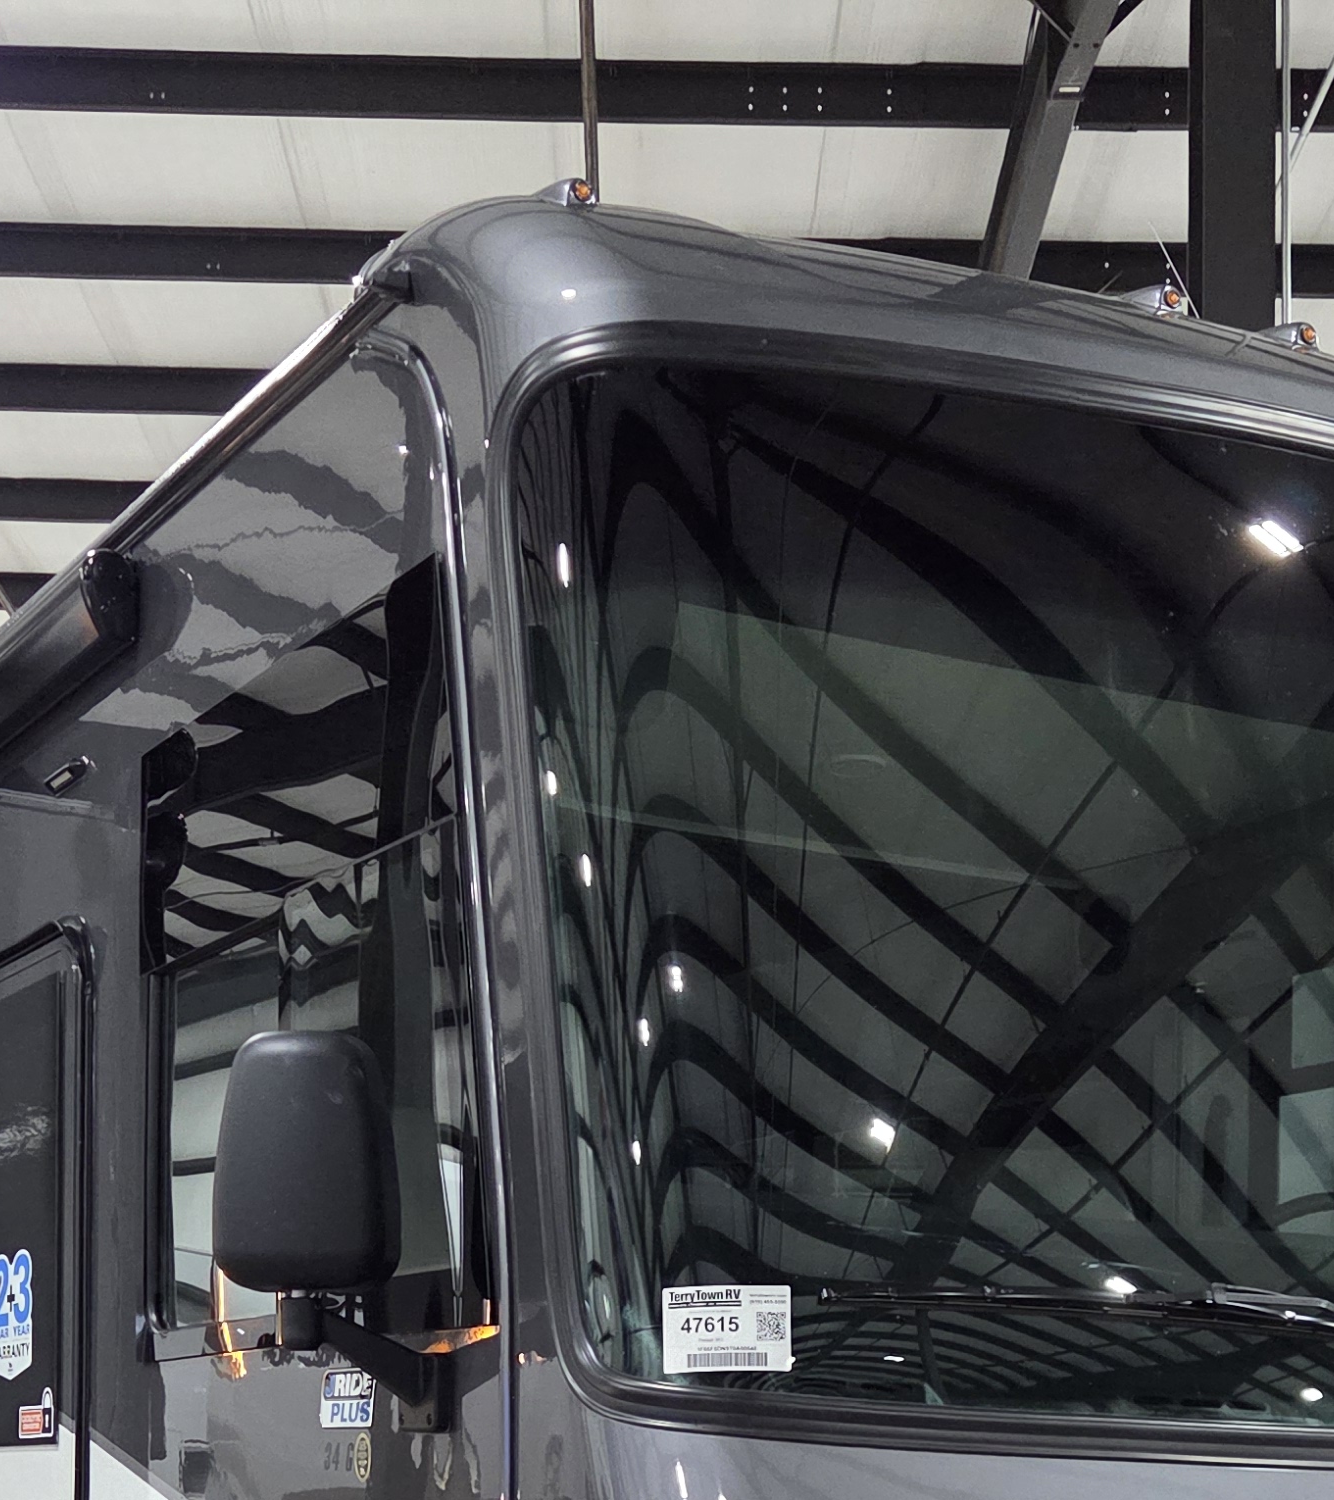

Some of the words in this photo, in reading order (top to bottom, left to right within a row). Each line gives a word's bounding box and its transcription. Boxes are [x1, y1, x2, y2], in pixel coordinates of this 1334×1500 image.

[725, 1288, 742, 1300] RV
[13, 1324, 30, 1337] YEAR
[680, 1316, 740, 1334] 47615
[330, 1400, 371, 1423] PLUS
